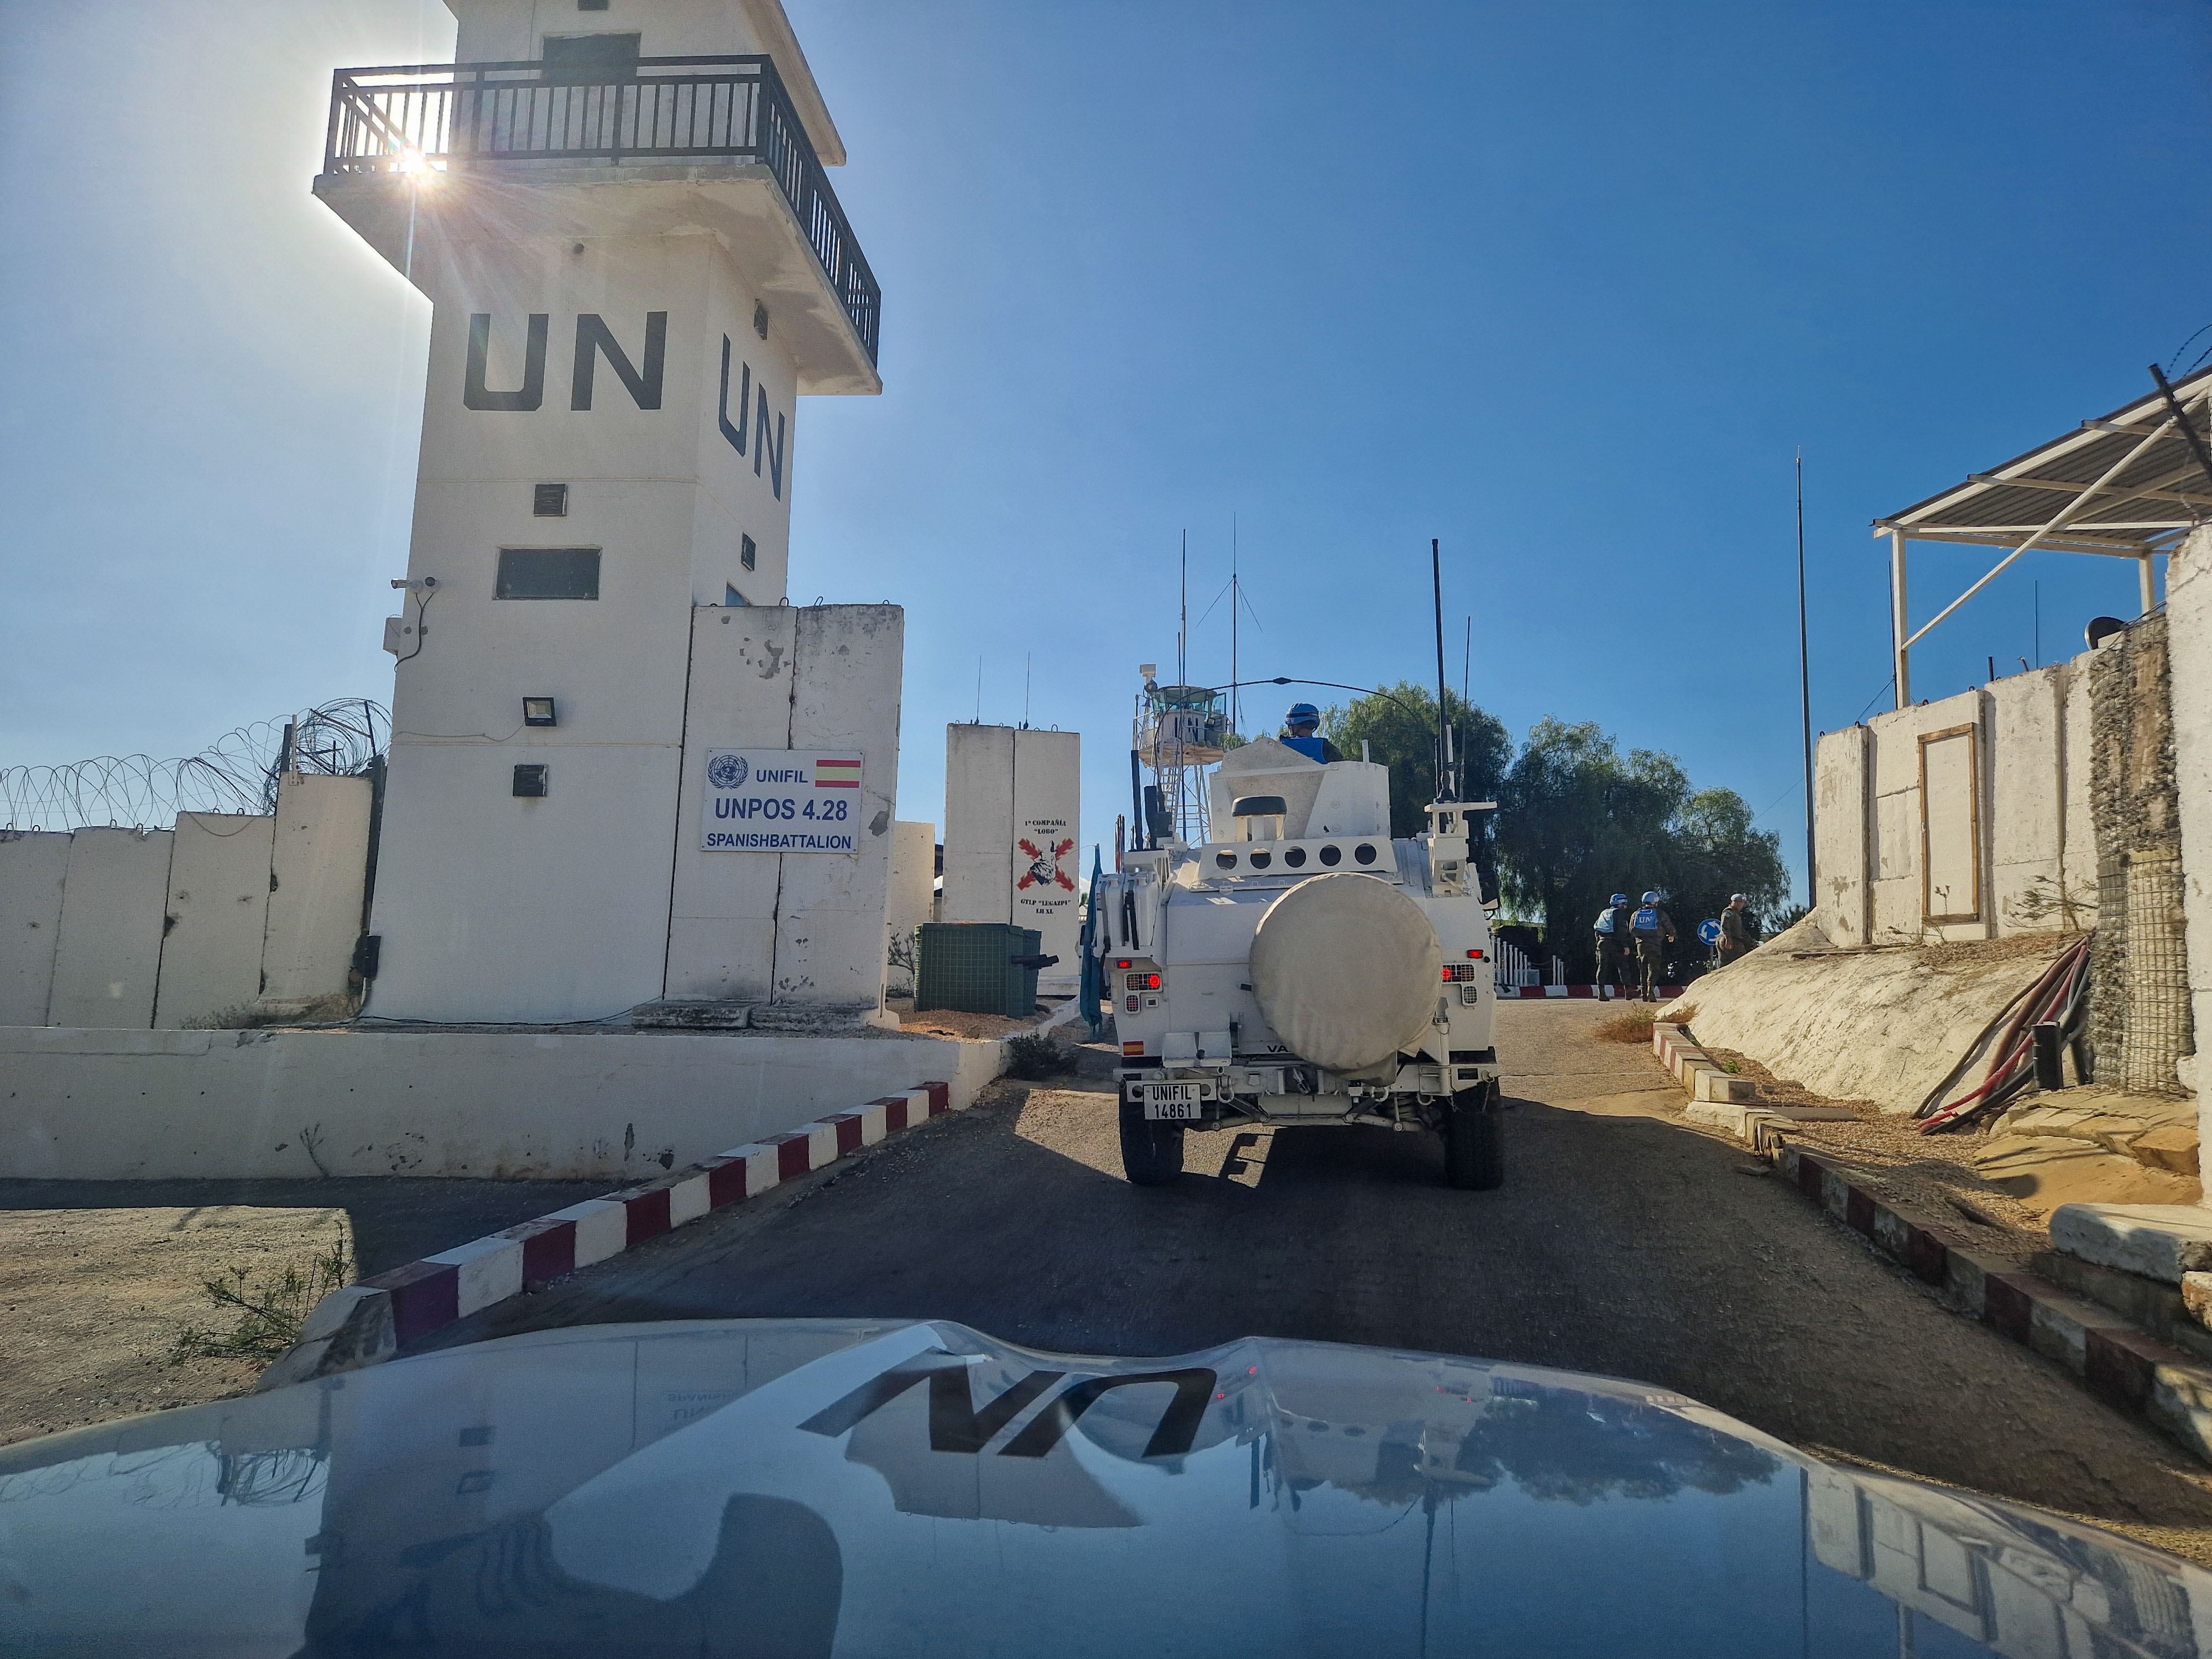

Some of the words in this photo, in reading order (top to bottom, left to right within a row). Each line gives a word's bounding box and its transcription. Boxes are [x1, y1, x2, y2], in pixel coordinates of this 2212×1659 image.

[463, 311, 667, 411] UN
[718, 332, 785, 502] UN
[756, 769, 808, 783] UNIFIL
[715, 797, 795, 820] UNPOS
[802, 799, 848, 821] 4.28
[707, 833, 852, 849] SPANISHBATTALION
[1266, 1045, 1292, 1053] VA
[1152, 1086, 1192, 1100] UNIFIL
[1155, 1103, 1191, 1118] 14861
[796, 1345, 1217, 1458] UN
